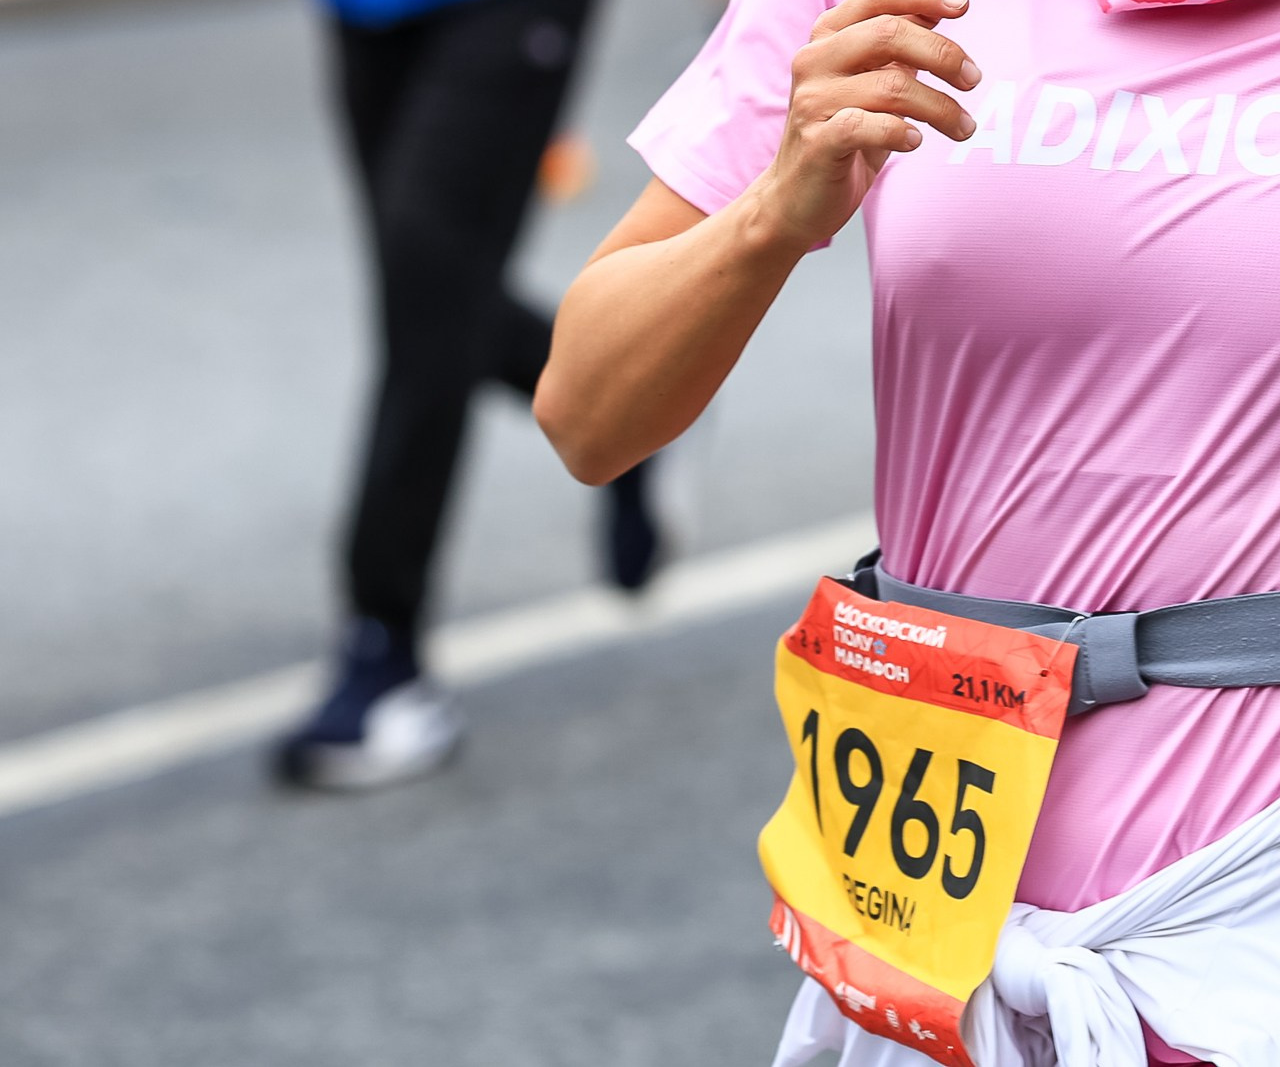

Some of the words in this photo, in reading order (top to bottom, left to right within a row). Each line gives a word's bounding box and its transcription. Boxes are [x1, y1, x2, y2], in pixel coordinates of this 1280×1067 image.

[833, 625, 874, 652] ПОЛУ
[834, 601, 947, 648] МОСКОВСКИЙ
[834, 646, 910, 683] МАРАФОН
[801, 708, 996, 900] 1965
